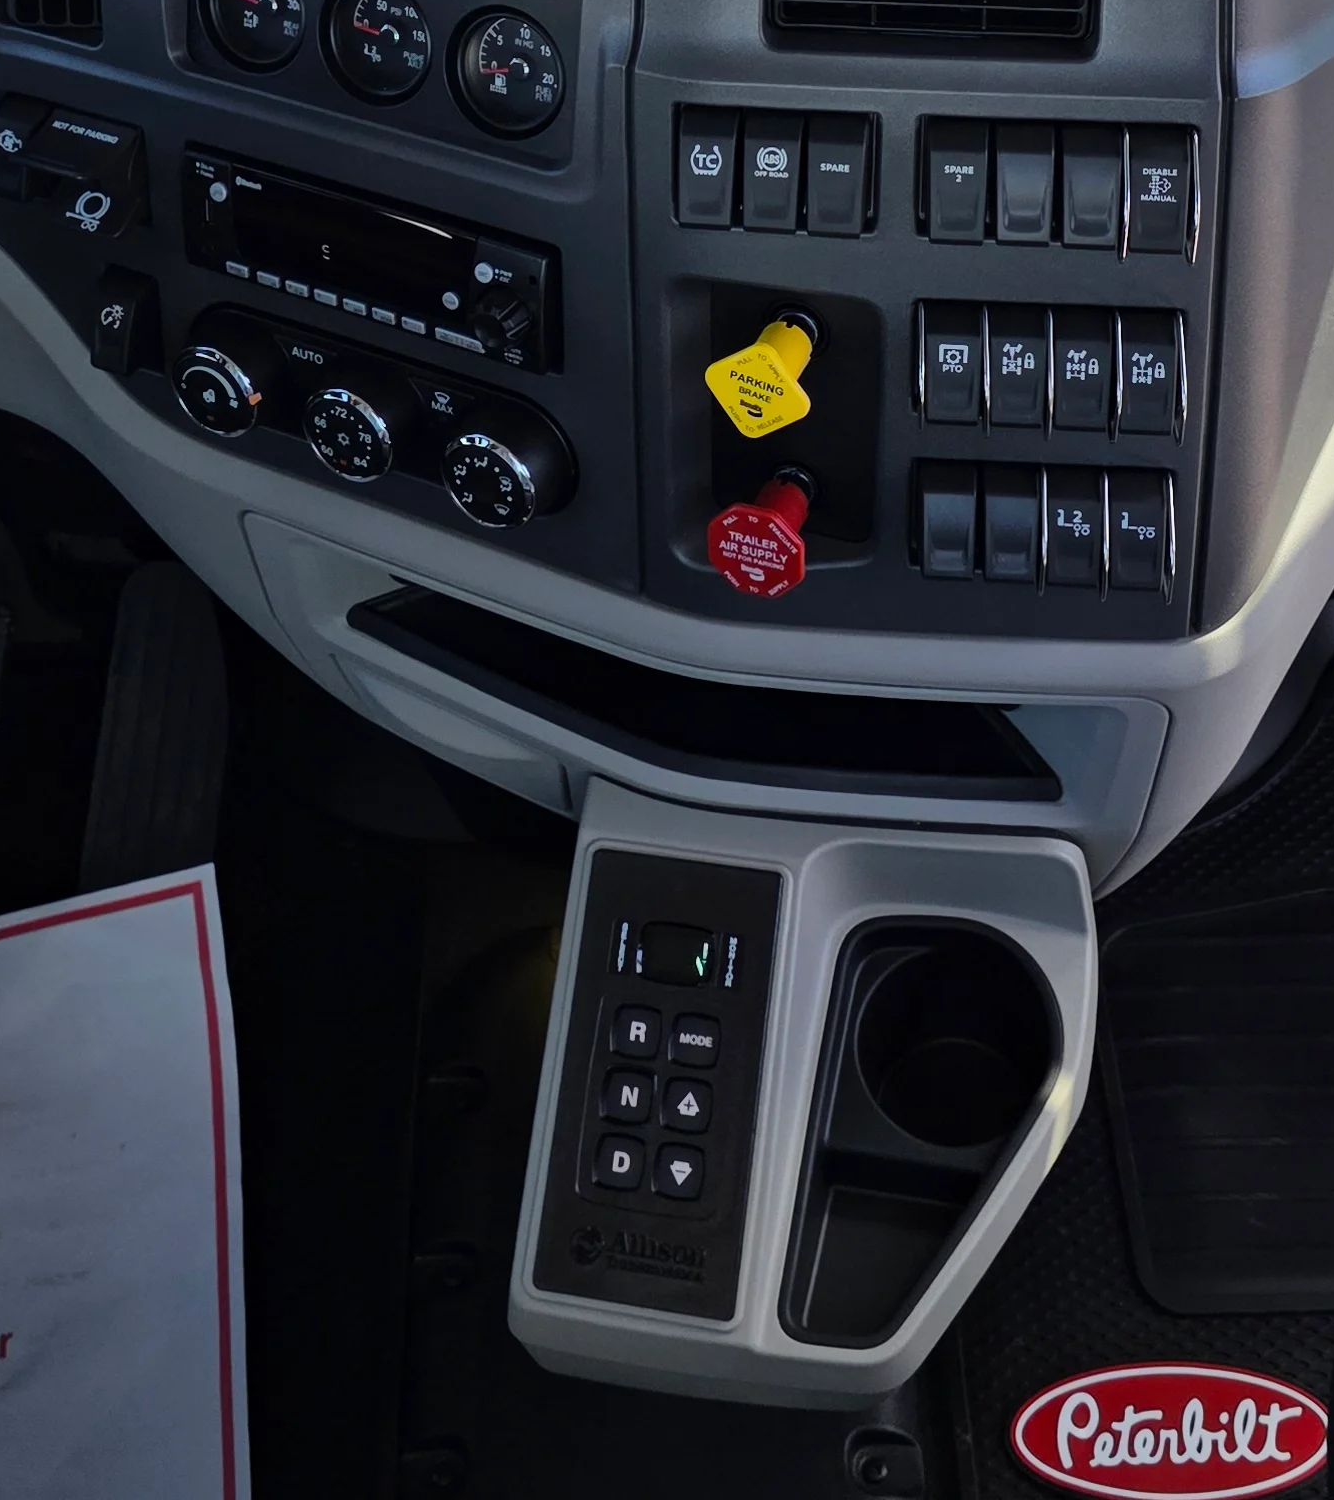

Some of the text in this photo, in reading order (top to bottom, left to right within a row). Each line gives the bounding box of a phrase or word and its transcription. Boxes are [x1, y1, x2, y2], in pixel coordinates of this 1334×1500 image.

[376, 0, 388, 12] 50
[390, 6, 403, 17] PSI
[497, 35, 504, 46] 5
[519, 27, 531, 40] 10
[540, 45, 552, 57] 15
[542, 73, 554, 85] 20
[52, 120, 119, 144] NOT FOR PARKING
[696, 153, 717, 168] TC
[763, 154, 780, 165] ABS
[820, 163, 850, 173] SPARE
[944, 165, 974, 175] SPARE
[1142, 167, 1178, 177] DISABLE
[956, 174, 962, 182] 2
[1141, 194, 1177, 203] MANUAL
[291, 346, 324, 364] AUTO
[757, 353, 767, 361] TO
[767, 363, 785, 383] APPLY
[942, 365, 964, 373] PTO
[730, 370, 784, 396] PARKING
[739, 386, 772, 404] BRAKE
[334, 406, 347, 419] 72
[431, 401, 454, 415] MAX
[314, 416, 327, 428] 66
[745, 425, 755, 433] TO
[756, 415, 784, 430] RELEASE
[358, 432, 372, 444] 78
[320, 445, 333, 456] 60
[353, 457, 367, 468] 84
[728, 530, 778, 551] TRAILER
[748, 515, 759, 524] TO
[768, 523, 798, 555] EVACUATE
[719, 540, 788, 564] AIR SUPPLY
[722, 551, 785, 571] NOT FOR PARKING
[723, 570, 740, 588] PUSH
[749, 585, 759, 594] TO
[629, 1020, 647, 1043] R
[679, 1032, 713, 1048] MODE
[621, 1085, 639, 1108] N
[612, 1150, 631, 1173] D
[607, 1229, 707, 1268] Allison
[1056, 1391, 1303, 1470] Peterbilt
